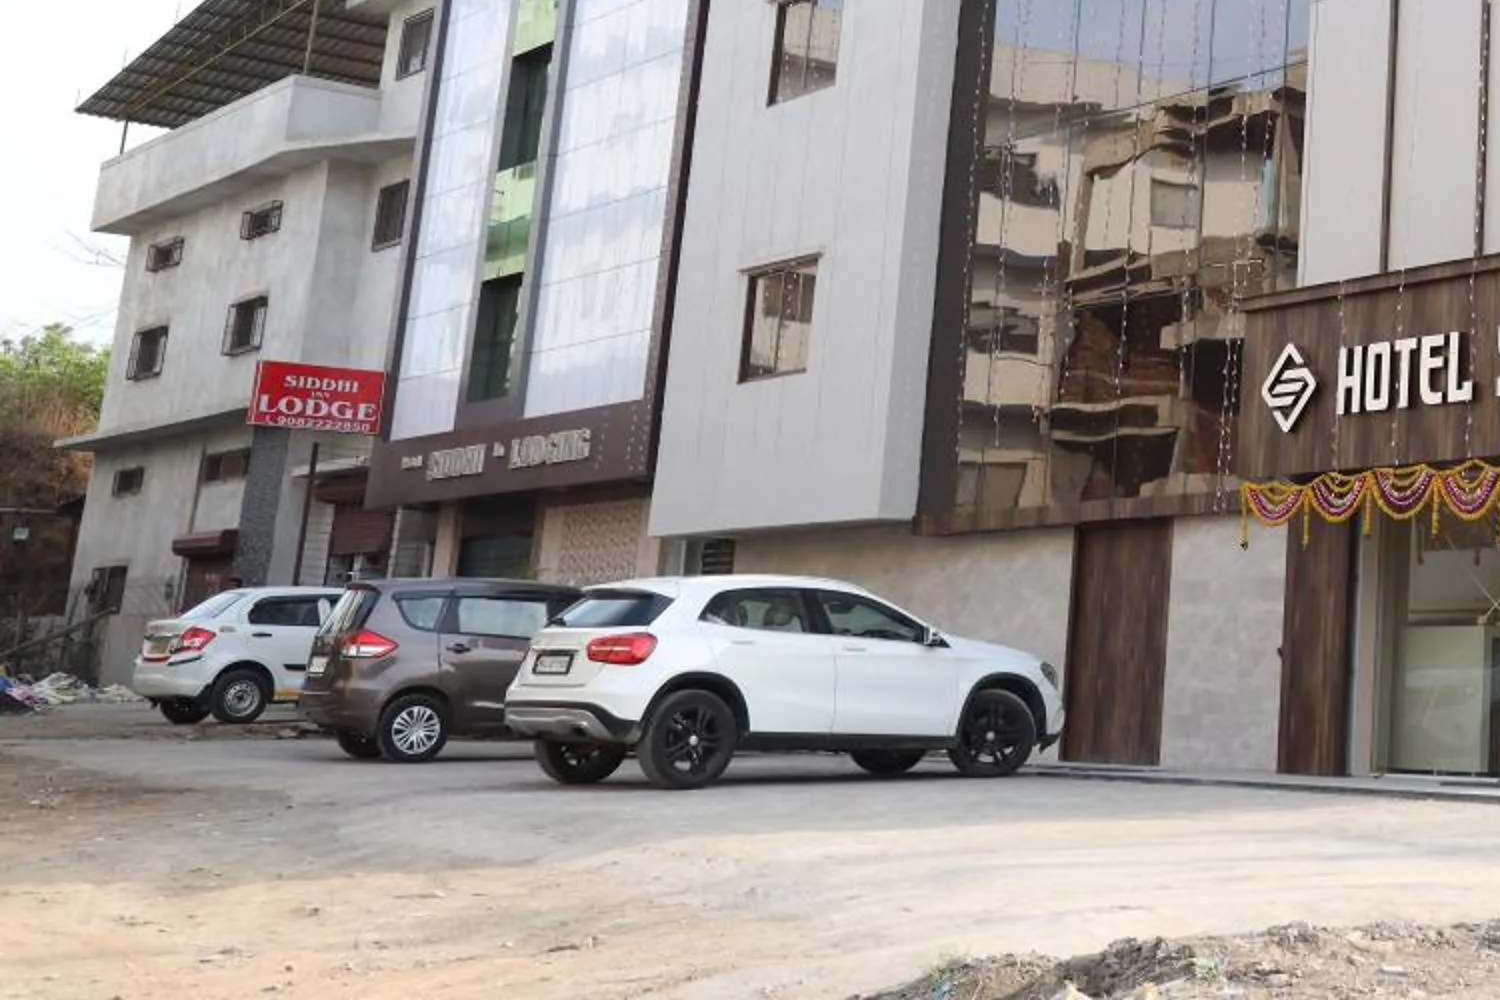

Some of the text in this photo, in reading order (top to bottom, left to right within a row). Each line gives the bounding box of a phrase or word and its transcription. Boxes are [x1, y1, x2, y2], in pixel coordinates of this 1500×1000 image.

[284, 374, 359, 393] SIDDHI
[1336, 331, 1474, 416] HOTEL
[258, 393, 377, 421] LODGE
